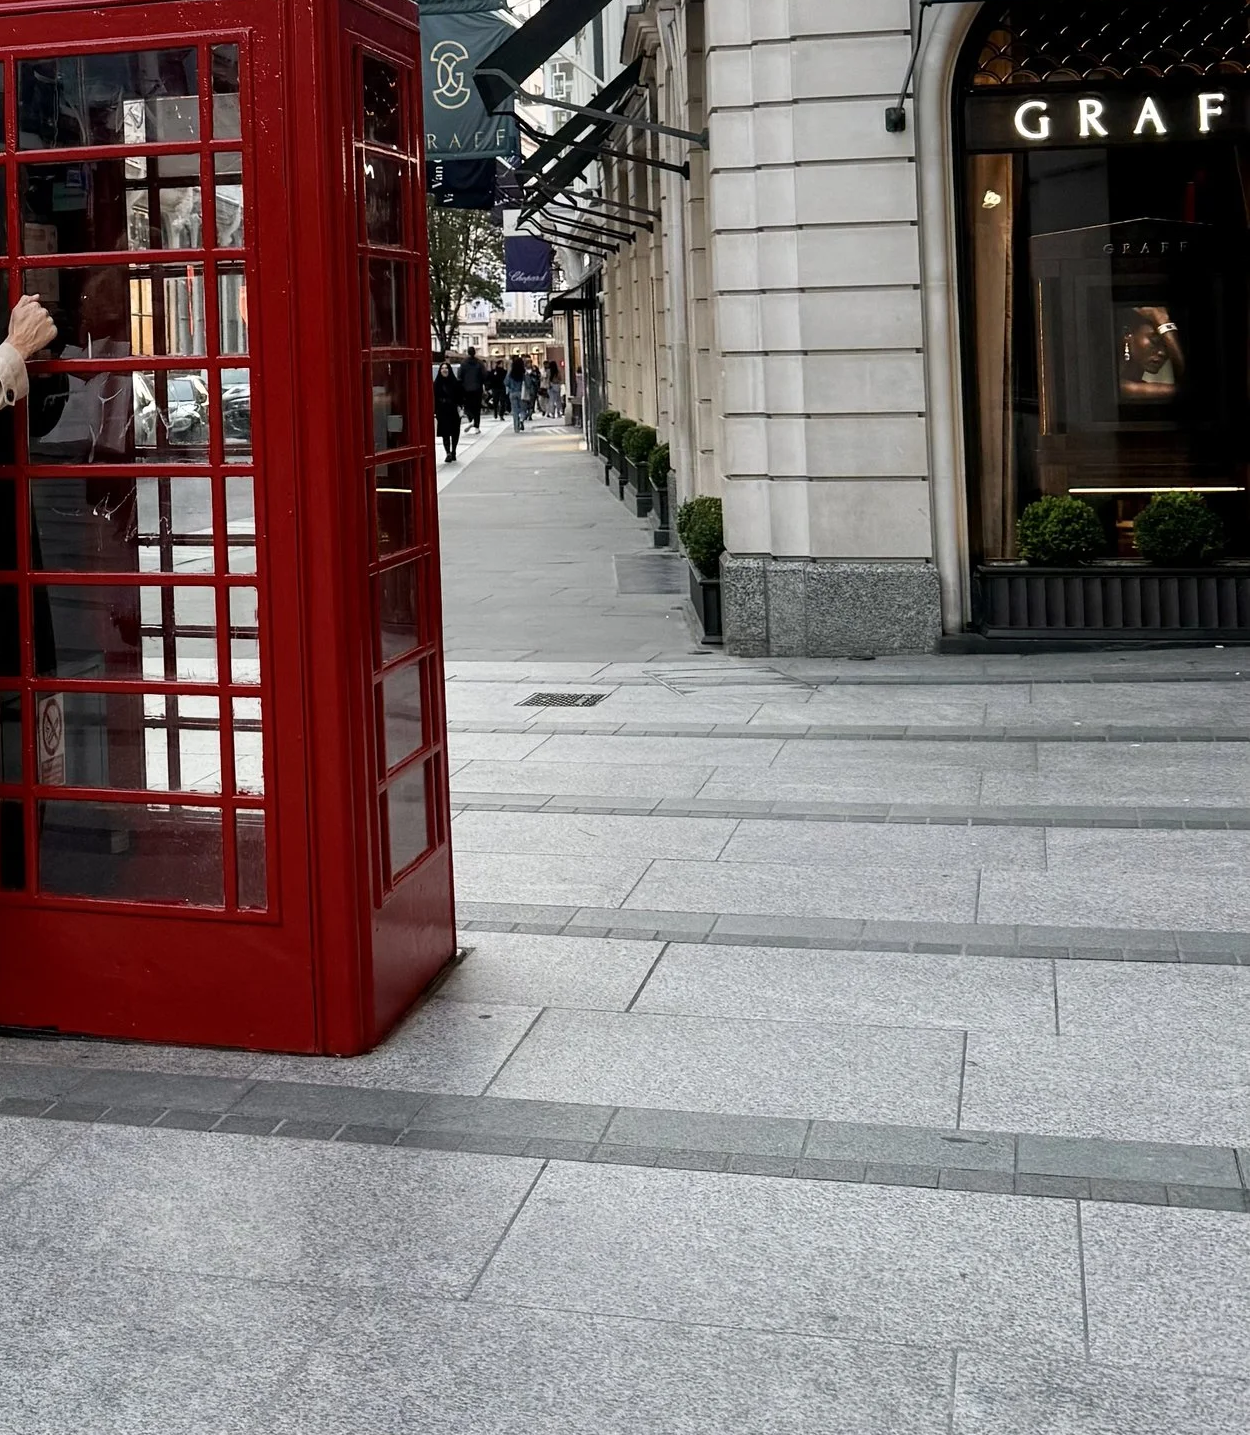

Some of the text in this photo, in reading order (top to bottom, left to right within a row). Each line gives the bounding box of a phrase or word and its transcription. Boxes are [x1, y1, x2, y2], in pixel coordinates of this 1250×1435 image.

[1014, 93, 1224, 140] GRAF
[427, 129, 505, 149] RAFF
[432, 166, 443, 189] Van
[510, 270, 548, 284] Chopard
